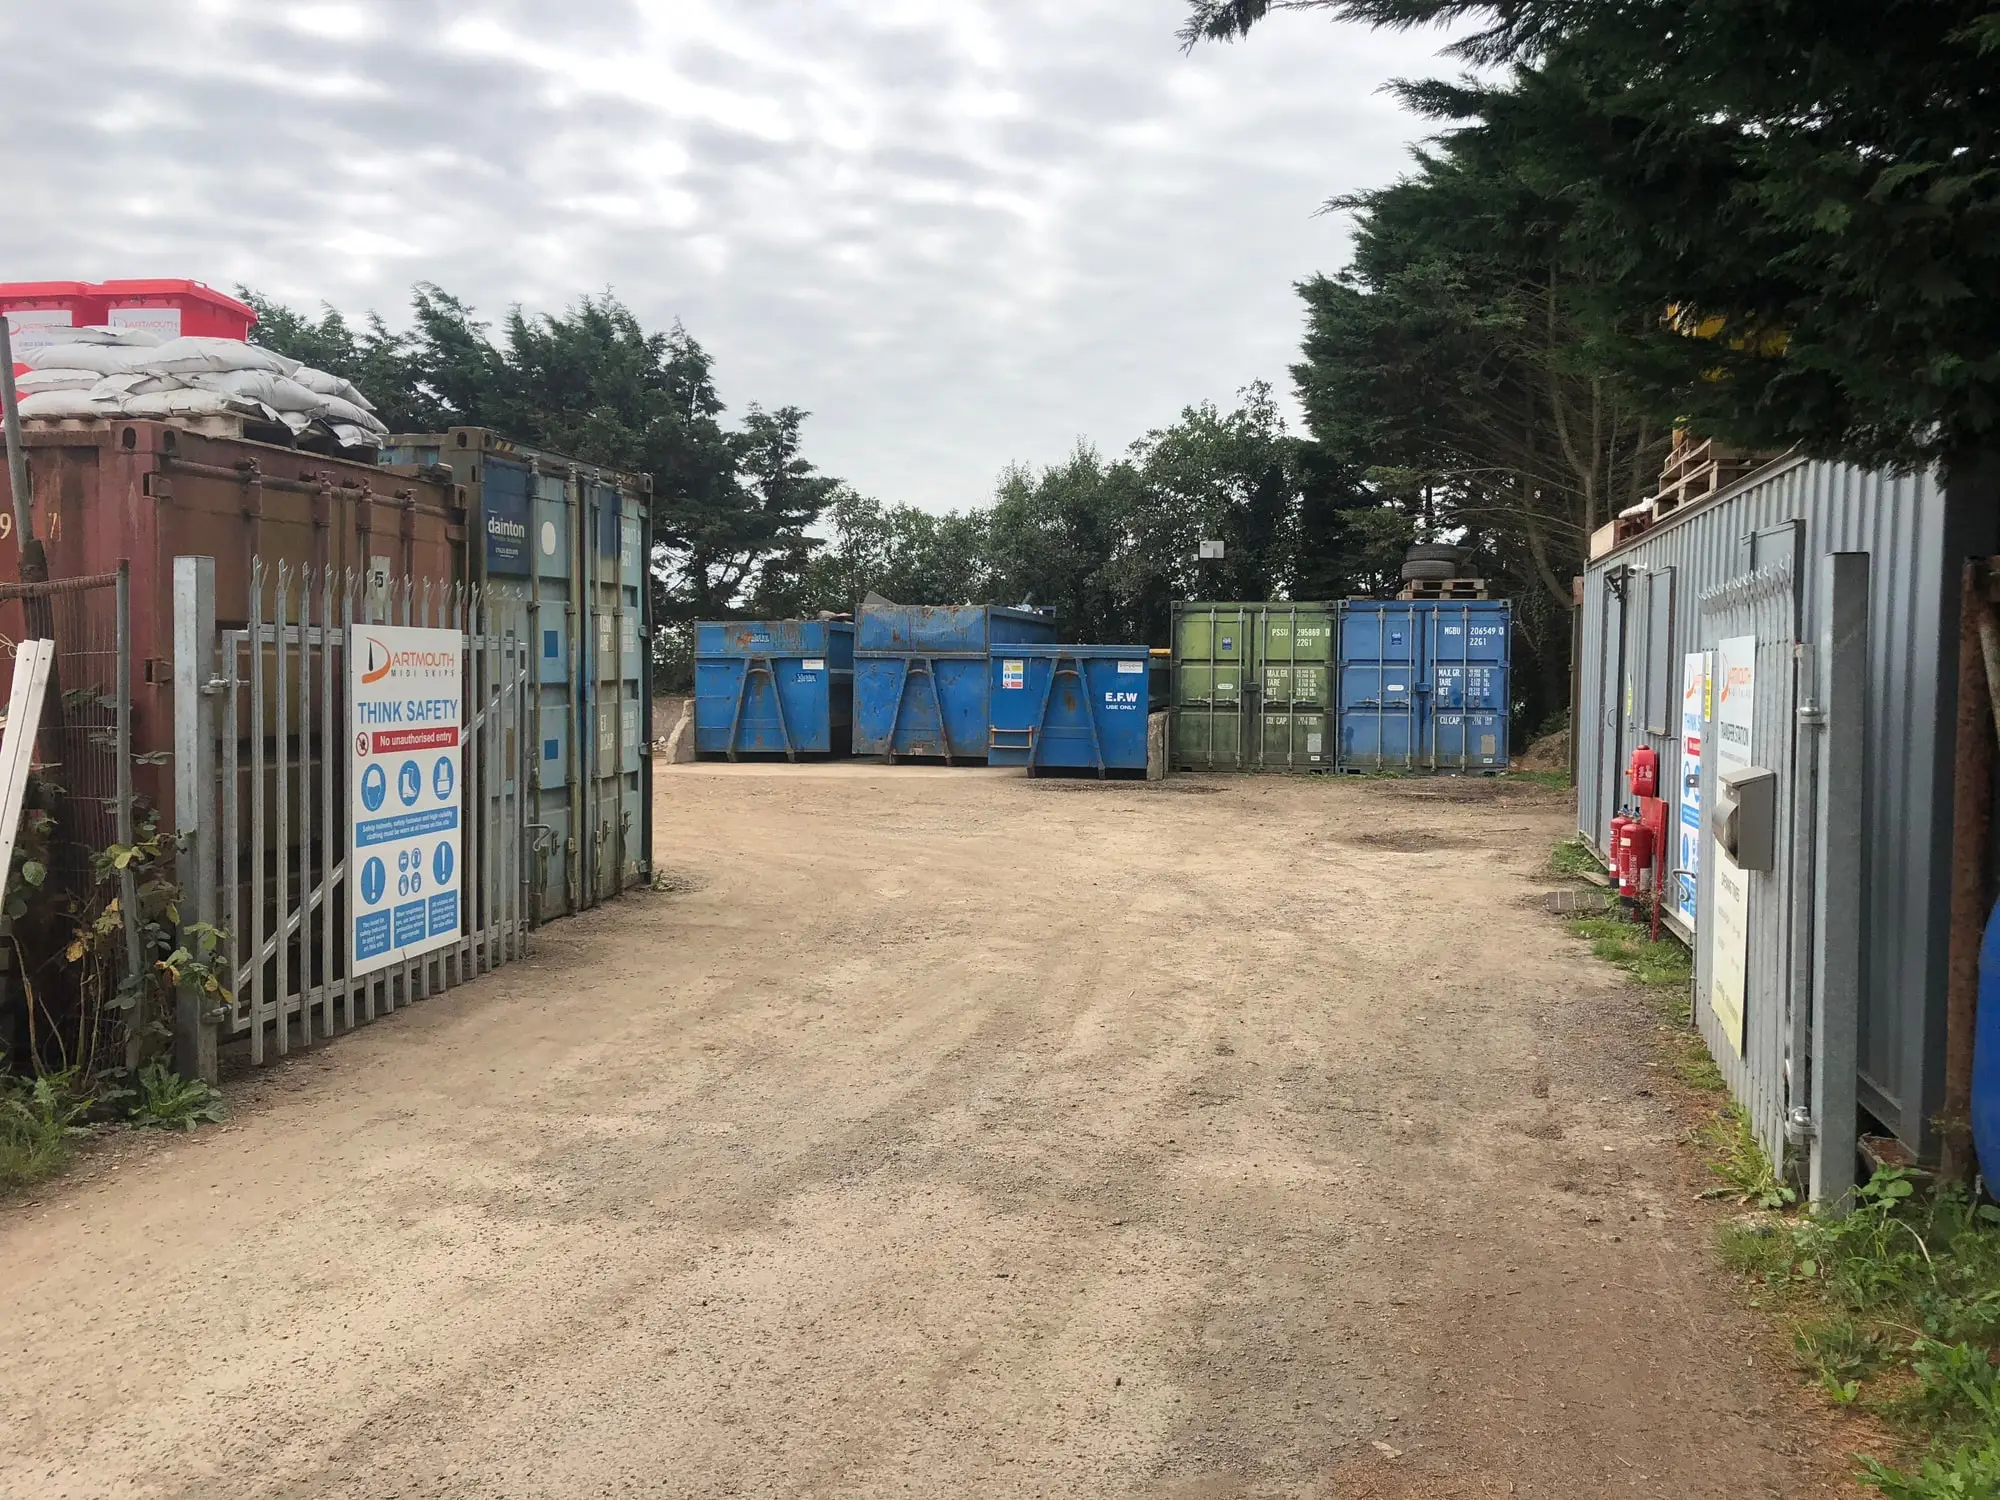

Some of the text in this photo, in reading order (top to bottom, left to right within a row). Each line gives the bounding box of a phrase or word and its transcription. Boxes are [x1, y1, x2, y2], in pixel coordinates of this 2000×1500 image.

[488, 516, 525, 538] dainton
[375, 571, 383, 588] 5
[1272, 628, 1289, 637] PSSU
[1470, 627, 1496, 636] 206549
[1296, 638, 1312, 647] 22G1
[1469, 638, 1487, 646] 22G1
[425, 670, 454, 678] SKIPS
[1267, 679, 1280, 687] TARE
[1439, 678, 1452, 686] TARE
[1266, 688, 1277, 696] NET
[1438, 688, 1448, 696] NET
[358, 699, 458, 724] THINK SAFETY
[380, 732, 452, 747] No unauthorised entry
